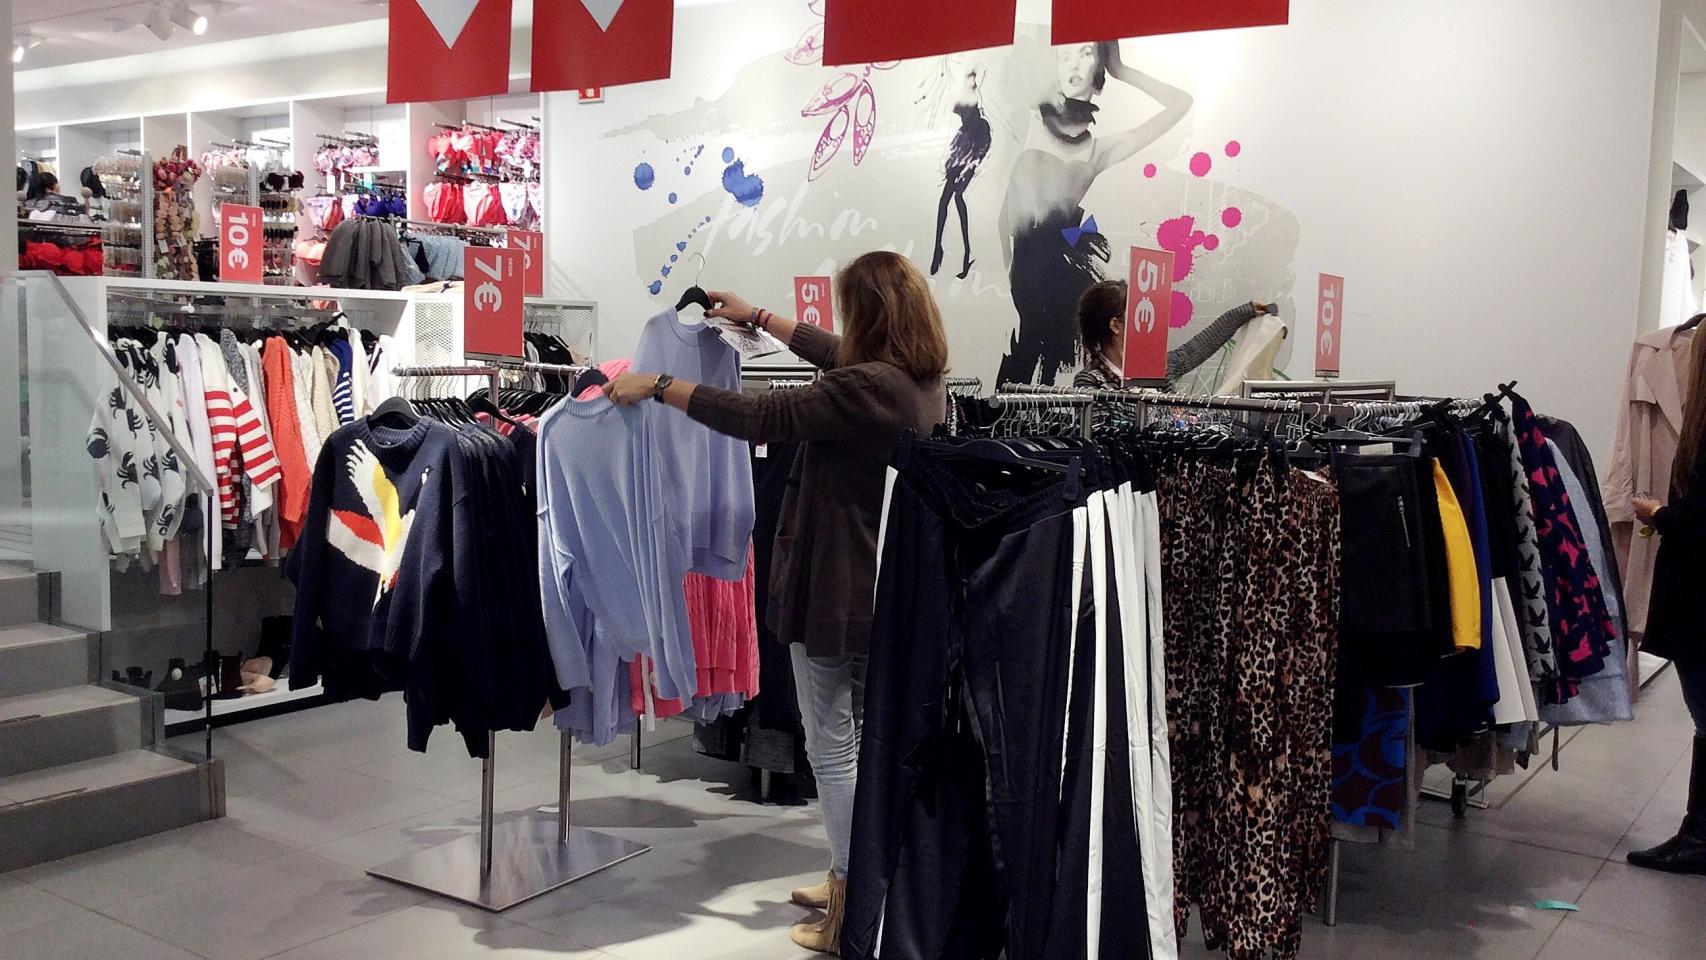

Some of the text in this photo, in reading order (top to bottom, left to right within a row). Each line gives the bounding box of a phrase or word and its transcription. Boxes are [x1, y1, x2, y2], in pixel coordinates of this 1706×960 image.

[228, 212, 249, 270] 10€
[474, 254, 502, 312] 7€
[801, 282, 821, 326] 5€
[1135, 258, 1159, 334] 5€
[1321, 283, 1336, 356] 10€
